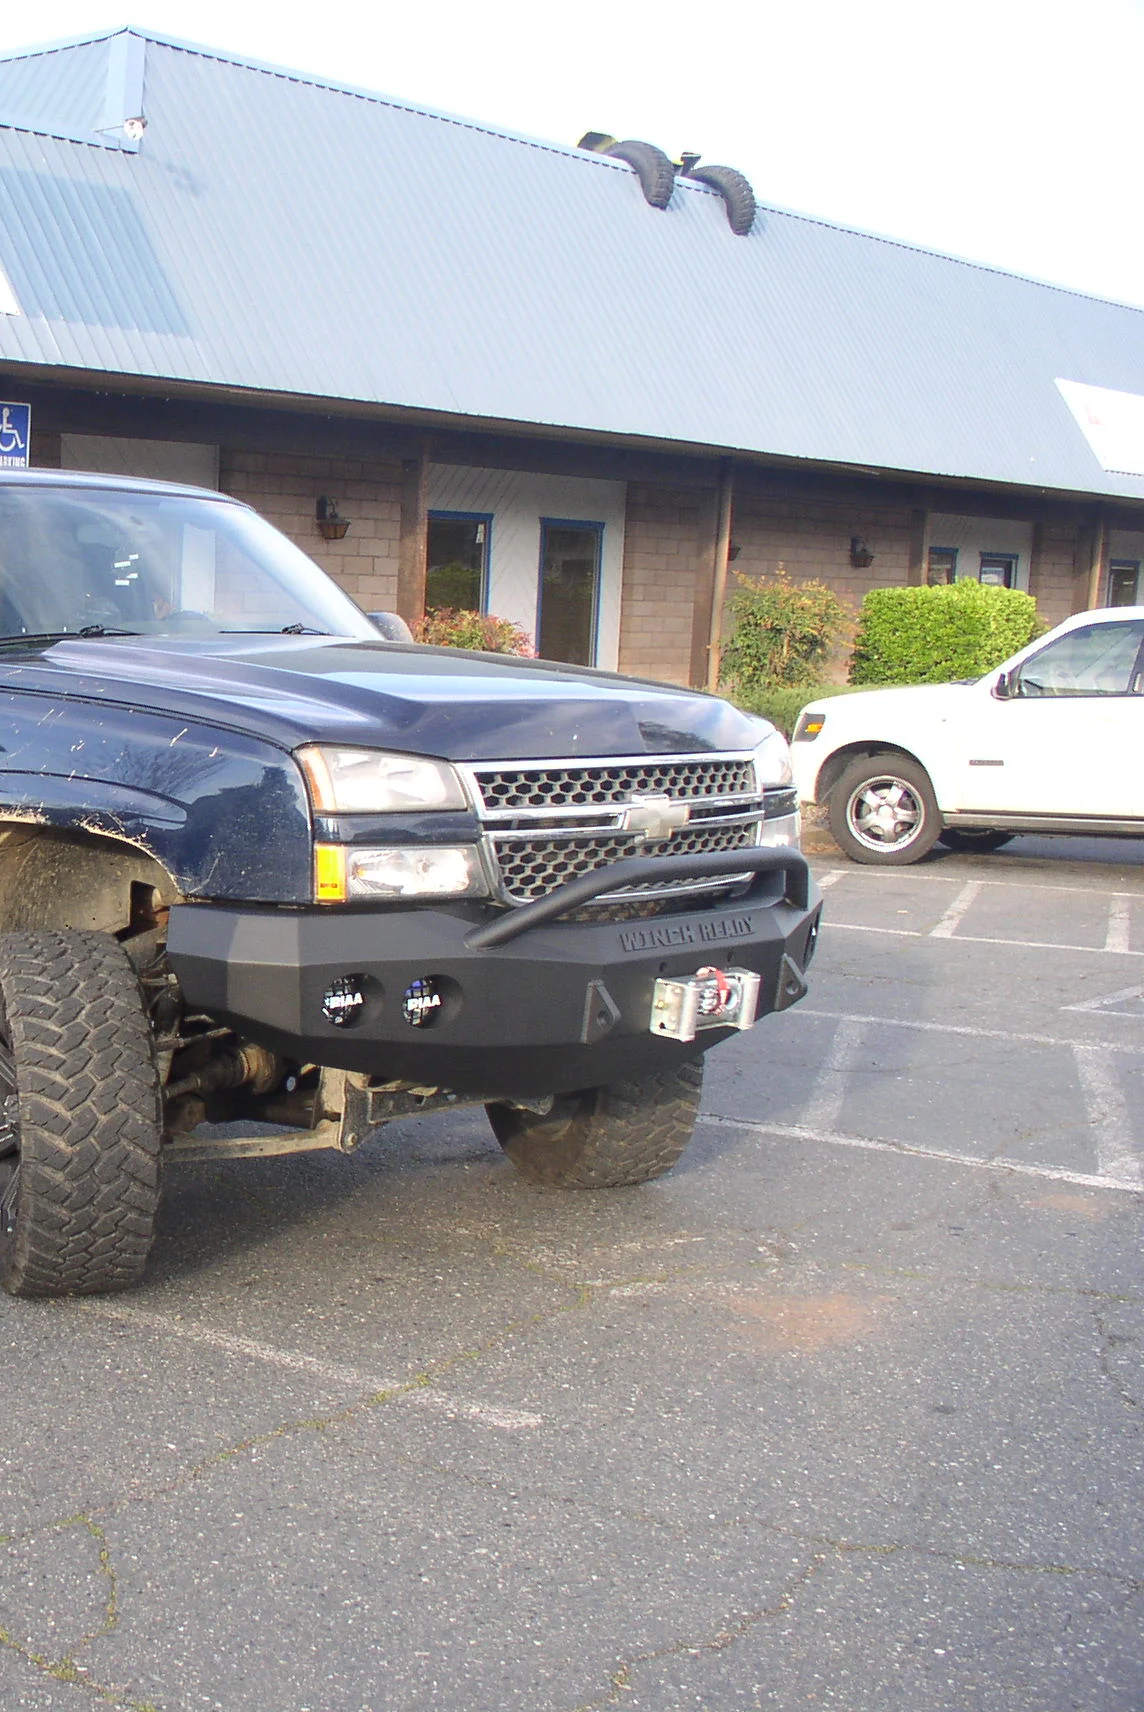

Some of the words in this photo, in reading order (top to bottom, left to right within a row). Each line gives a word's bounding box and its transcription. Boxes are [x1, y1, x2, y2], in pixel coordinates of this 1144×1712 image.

[619, 925, 694, 952] WINCH
[699, 917, 755, 941] READY
[407, 995, 441, 1010] PIAA
